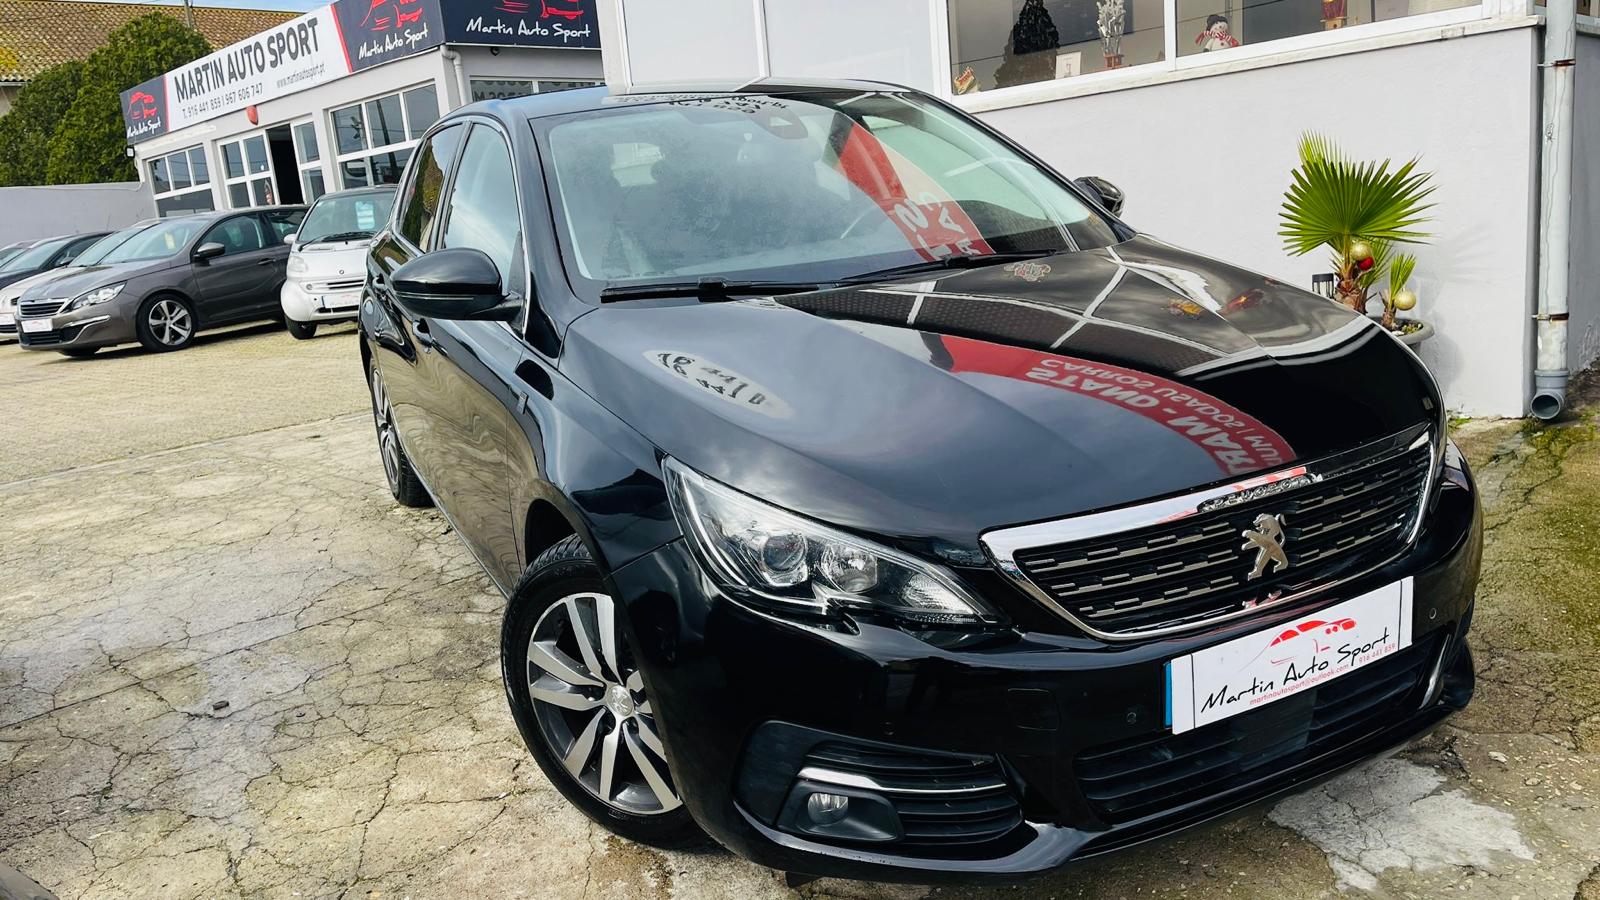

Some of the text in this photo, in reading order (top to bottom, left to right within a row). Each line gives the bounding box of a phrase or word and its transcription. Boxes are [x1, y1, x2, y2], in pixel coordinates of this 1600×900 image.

[358, 22, 429, 60] Martin Auto Sport
[466, 16, 591, 43] Martin Auto Sport
[174, 17, 318, 103] MARTIN AUTO SPORT
[251, 82, 263, 96] 747
[1200, 627, 1389, 713] Martin Auto Sport
